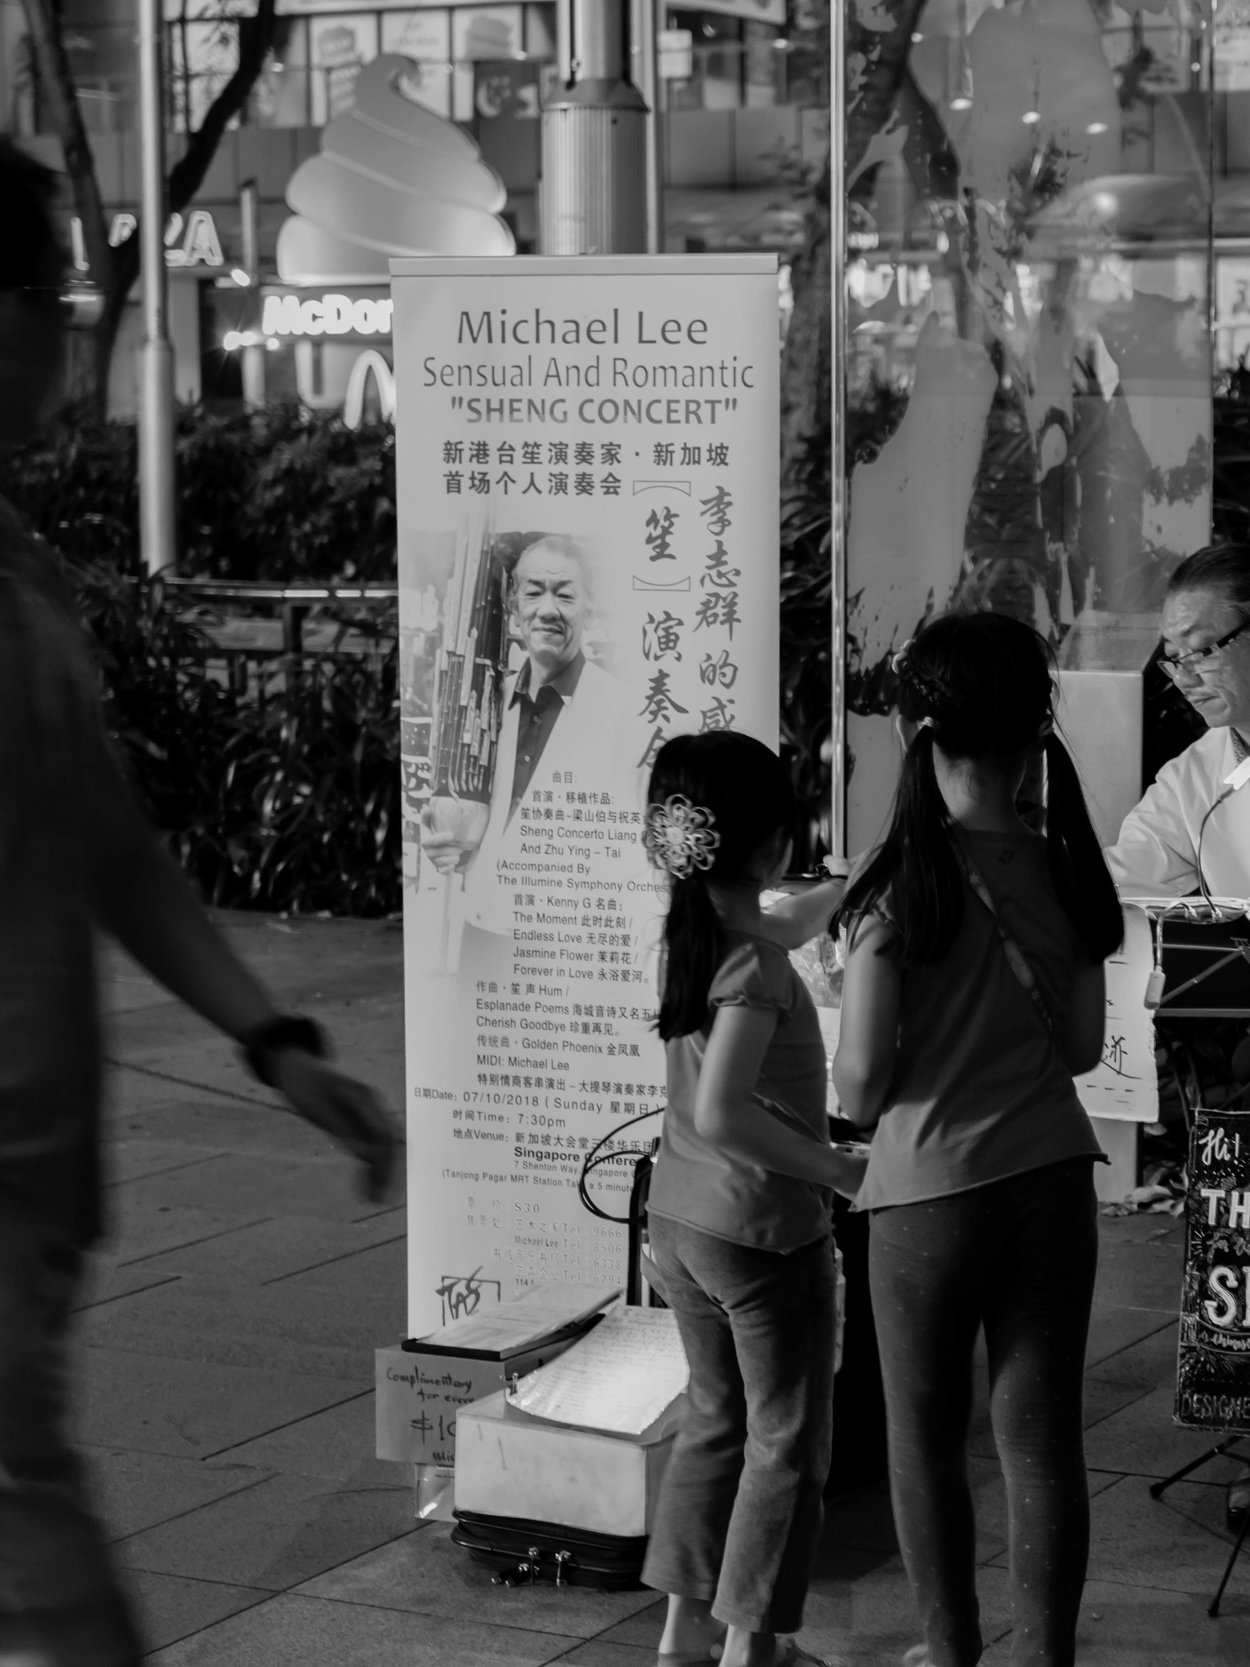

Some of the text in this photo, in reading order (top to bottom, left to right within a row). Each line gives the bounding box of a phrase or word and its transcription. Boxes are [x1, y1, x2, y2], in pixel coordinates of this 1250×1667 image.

[457, 308, 709, 345] Michael Lee
[423, 355, 754, 388] Sensual And Romantic
[451, 396, 737, 425] "SHENG CONCERT"
[443, 470, 623, 496] 首场个人演奏会
[520, 825, 638, 842] Sheng Concerto Liang
[520, 843, 541, 855] And
[544, 843, 563, 856] Zhu
[567, 845, 591, 859] Ying
[604, 846, 621, 858] Tai
[497, 860, 591, 876] (Accompanied By
[497, 875, 518, 886] The
[521, 876, 563, 888] Illumine
[566, 877, 623, 892] Symphony
[582, 897, 592, 909] G
[513, 911, 533, 923] The
[536, 912, 578, 926] Moment
[513, 929, 554, 942] Endless
[557, 931, 583, 944] Love
[586, 933, 631, 947] 无尽的爱
[513, 947, 556, 960] Jasmine
[559, 949, 594, 962] Flower
[597, 951, 631, 965] 茉莉花
[513, 964, 553, 977] Forever
[556, 965, 566, 977] in
[569, 966, 593, 979] Love
[539, 984, 563, 996] Hum
[476, 999, 531, 1013] Esplanade
[534, 1002, 570, 1015] Poems
[476, 1016, 516, 1029] Cherish
[519, 1018, 566, 1033] Goodbye
[521, 1038, 559, 1051] Golden
[562, 1040, 603, 1054] Phoenix
[477, 1054, 570, 1071] MIDI: Michael Lee
[463, 1091, 540, 1107] 07/10/2018
[554, 1098, 603, 1114] Sunday
[517, 1113, 566, 1129] 7:30pm
[514, 1146, 580, 1162] Singapore
[522, 1161, 557, 1172] Shenton
[442, 1169, 479, 1182] (Tanjong
[482, 1172, 507, 1184] Pagar
[510, 1174, 530, 1184] MRT
[533, 1176, 563, 1187] Station
[545, 1237, 559, 1249] Lee
